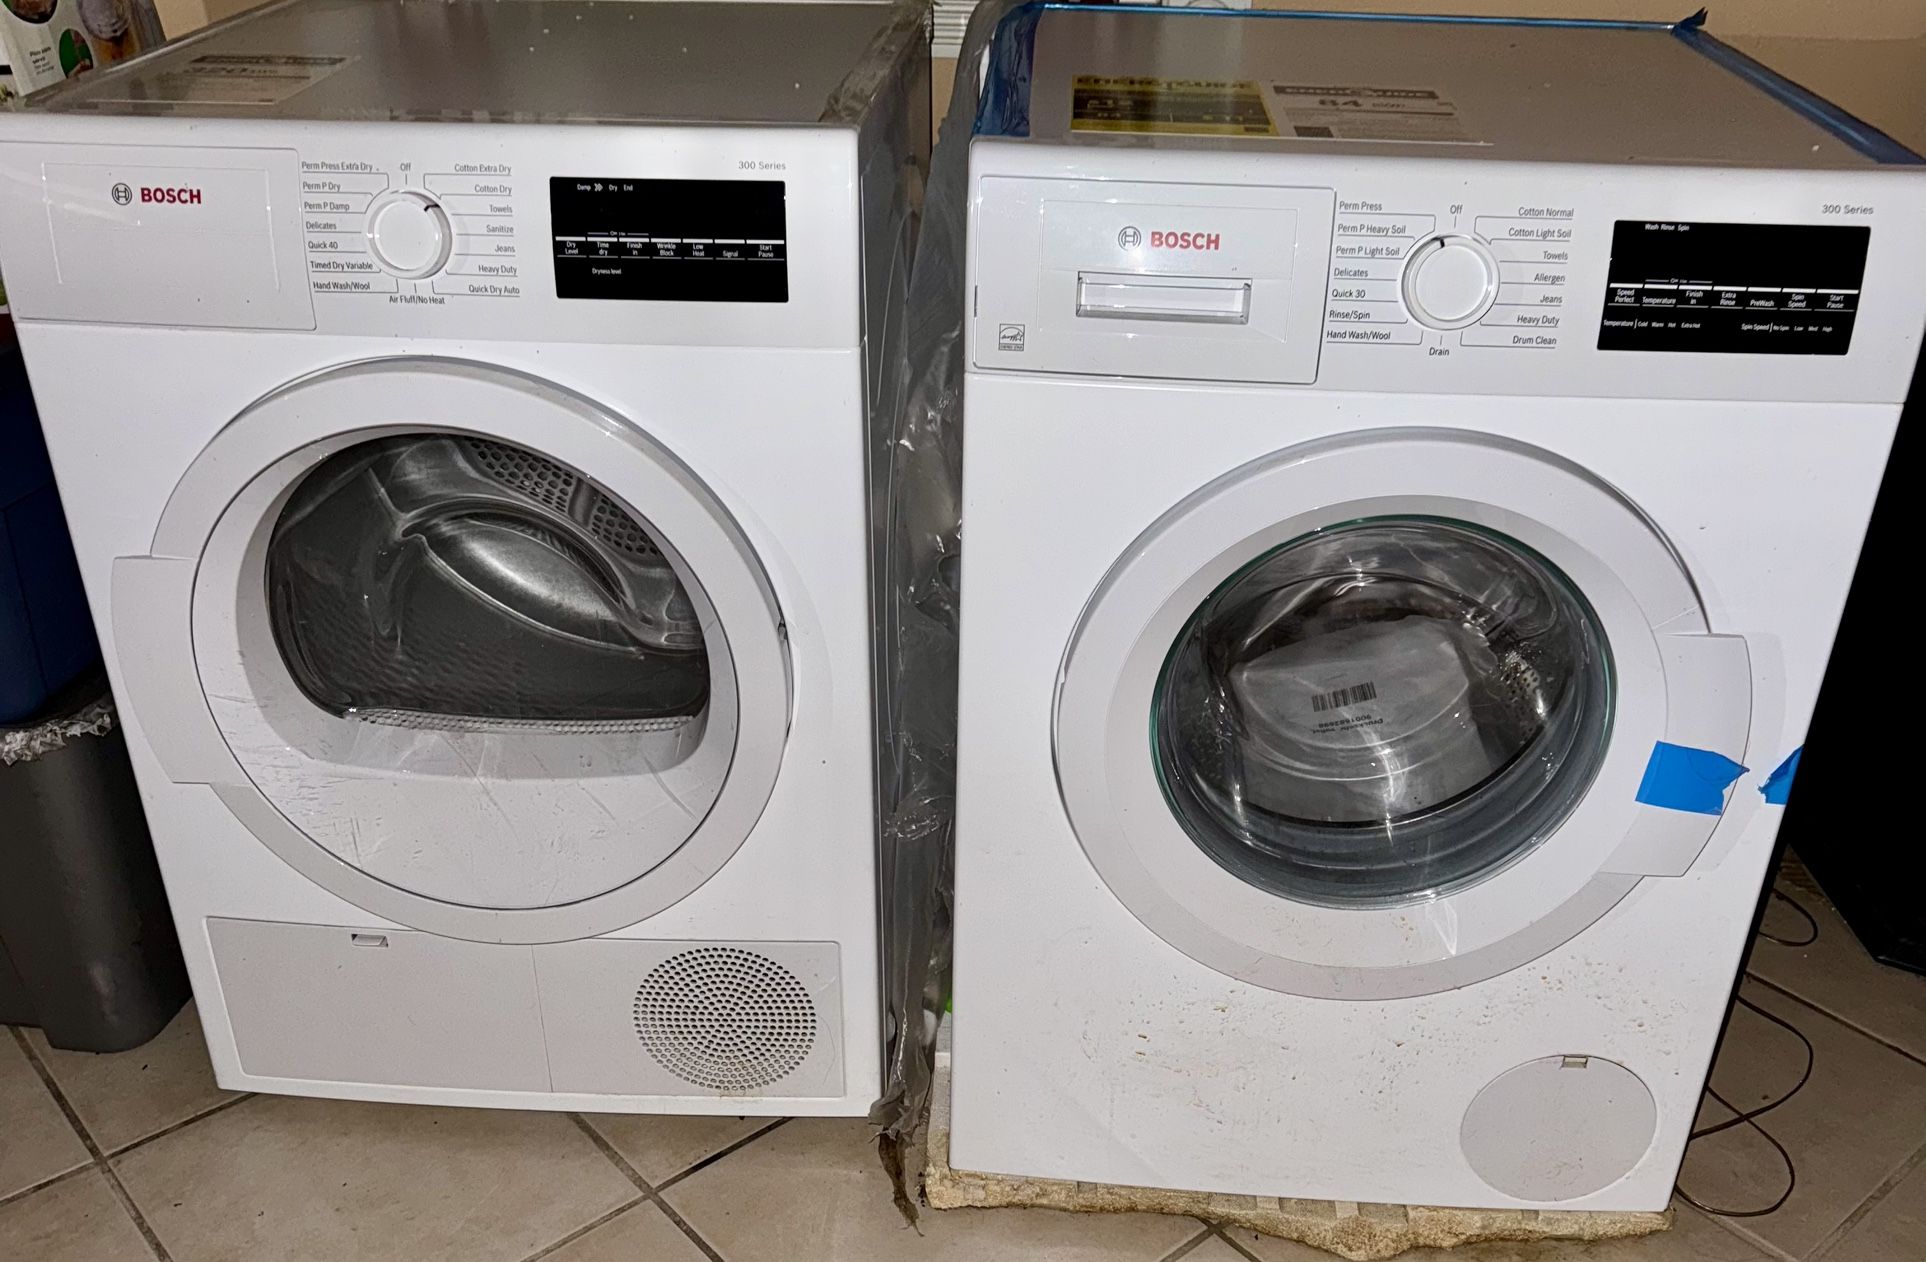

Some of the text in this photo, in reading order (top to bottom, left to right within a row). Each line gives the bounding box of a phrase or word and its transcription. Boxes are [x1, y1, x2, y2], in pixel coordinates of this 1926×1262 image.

[302, 161, 373, 172] Perm Press Extra Dry
[400, 163, 411, 172] Off
[454, 164, 512, 174] Cotton Extra Dry
[738, 161, 786, 170] 300 Series
[303, 182, 320, 190] Perm
[328, 182, 341, 192] Dry
[474, 184, 512, 194] Cotton Dry
[140, 187, 202, 204] BOSCH
[304, 202, 350, 212] Perm P Damp
[489, 204, 512, 213] Towels
[1339, 200, 1382, 212] Perm Press
[1450, 204, 1463, 214] Off
[1822, 204, 1874, 214] 300 Series
[1518, 206, 1574, 217] Cotton Normal
[306, 221, 336, 230] Delicates
[486, 224, 514, 233] Sanitize
[1338, 224, 1406, 235] Perm P Heavy Soil
[1508, 227, 1572, 240] Cotton Light Soil
[308, 241, 338, 250] Quick 40
[1151, 231, 1220, 250] BOSCH
[495, 245, 516, 253] Jeans
[1336, 246, 1400, 258] Perm P Light Soil
[1543, 250, 1568, 260] Towels
[310, 261, 374, 271] Timed Dry Variable
[478, 265, 518, 274] Heavy Duty
[1334, 268, 1368, 278] Delicates
[1534, 273, 1566, 284] Allergen
[332, 282, 370, 291] Wash/Wool
[468, 284, 520, 295] Quick Dry Auto
[1332, 289, 1366, 298] Quick 30
[400, 296, 428, 304] Fluff/No
[1540, 295, 1562, 304] Jeans
[1329, 310, 1370, 320] Rinse/Spin
[1516, 316, 1560, 327] Heavy Duty
[1326, 330, 1390, 340] Hand Wash/Wool
[1512, 336, 1557, 345] Drum Clean
[1429, 347, 1450, 356] Drain
